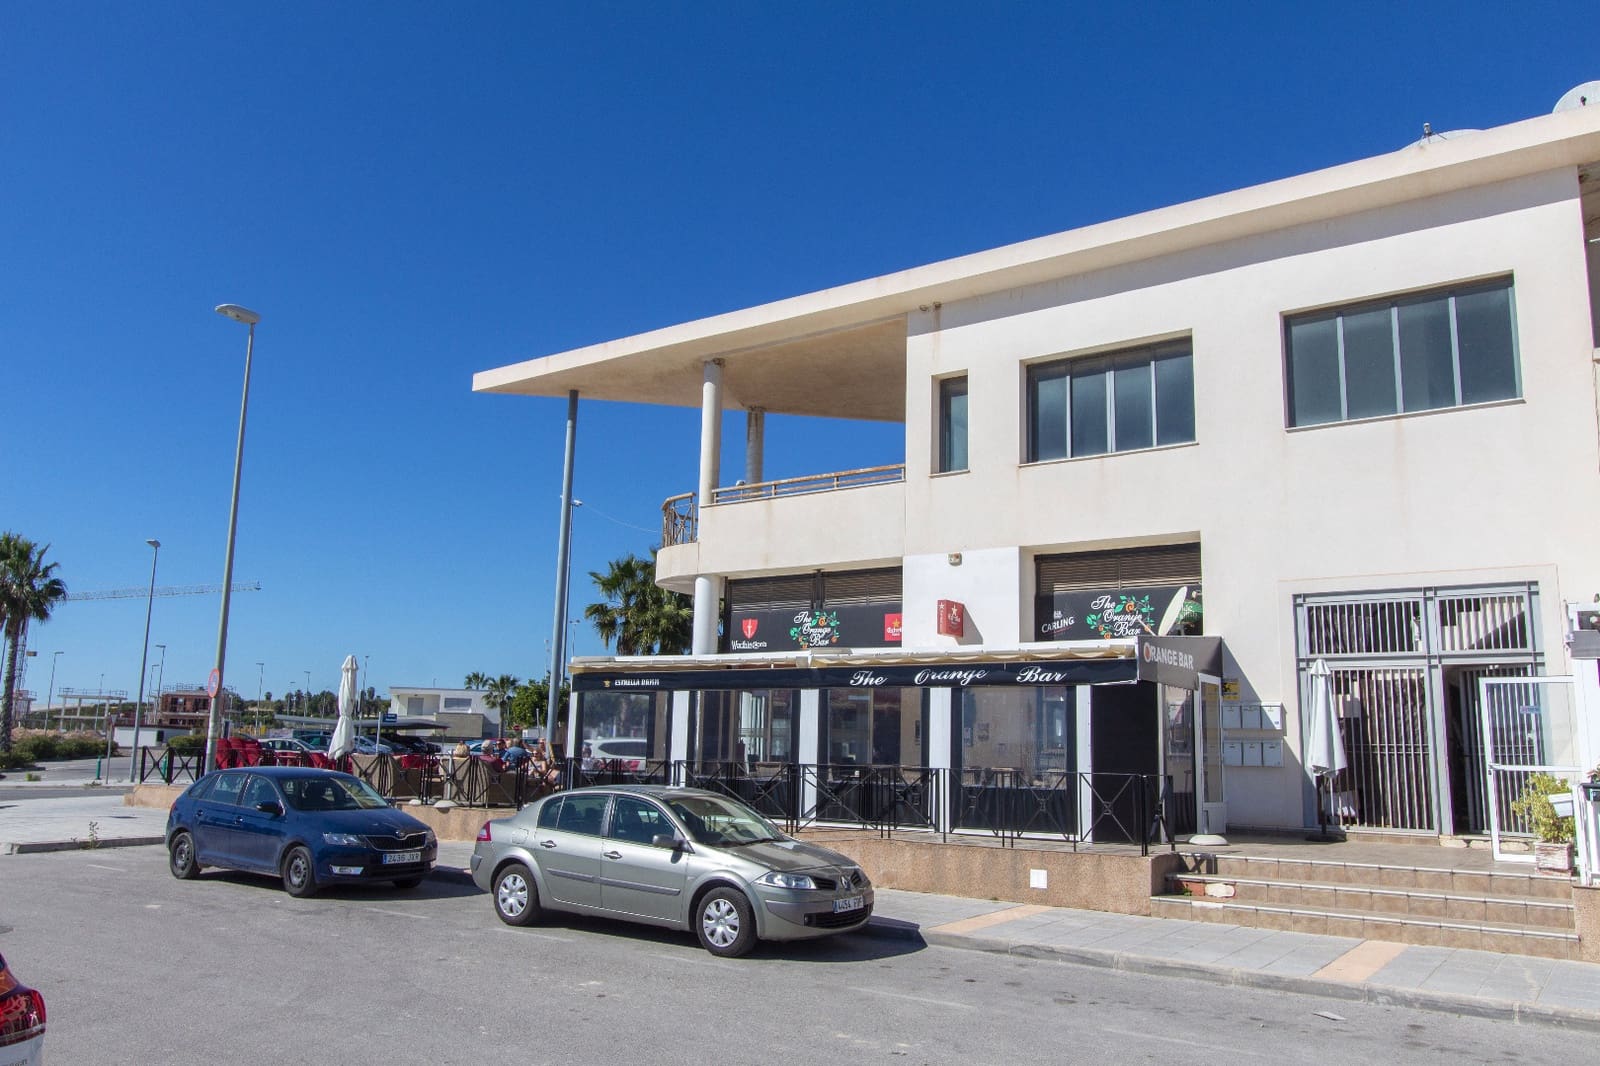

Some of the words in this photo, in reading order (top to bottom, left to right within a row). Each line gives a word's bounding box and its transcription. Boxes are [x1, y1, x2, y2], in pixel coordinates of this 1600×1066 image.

[1091, 594, 1116, 610] The
[793, 611, 812, 624] The
[1041, 616, 1075, 633] CARLING
[1103, 609, 1143, 627] Orange
[801, 623, 832, 638] Orange
[1113, 621, 1141, 636] Bar
[809, 634, 830, 646] Bar
[1143, 641, 1178, 666] ORANGE
[1178, 651, 1194, 670] BAR
[850, 670, 888, 686] The
[914, 668, 989, 686] Orange
[1016, 665, 1068, 683] Bar
